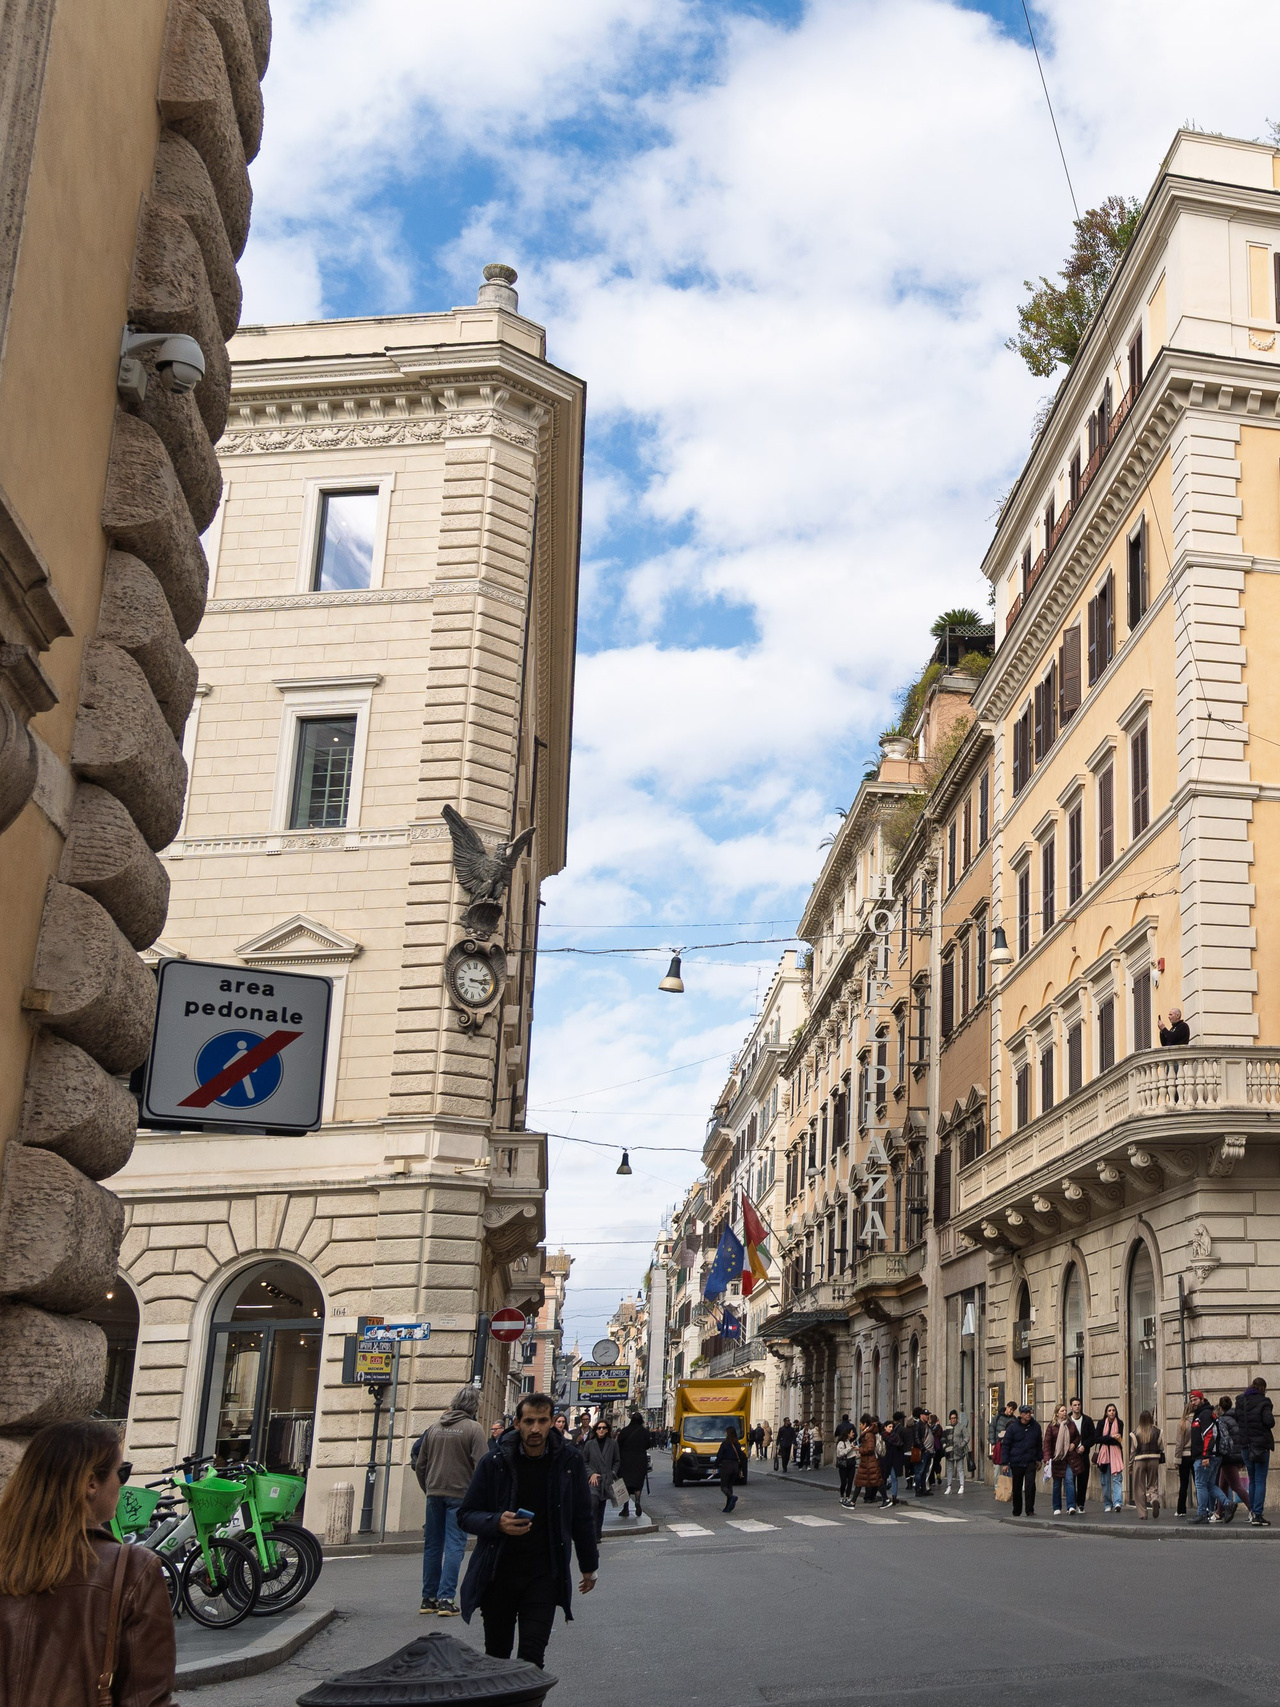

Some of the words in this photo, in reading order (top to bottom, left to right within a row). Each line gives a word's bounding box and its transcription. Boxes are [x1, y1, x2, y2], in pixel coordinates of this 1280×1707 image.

[866, 874, 896, 1042] HOTEL
[219, 979, 275, 997] area
[184, 1001, 303, 1024] pedonale
[859, 1065, 892, 1239] PLAZA
[333, 1307, 346, 1316] 164
[600, 1369, 609, 1379] &
